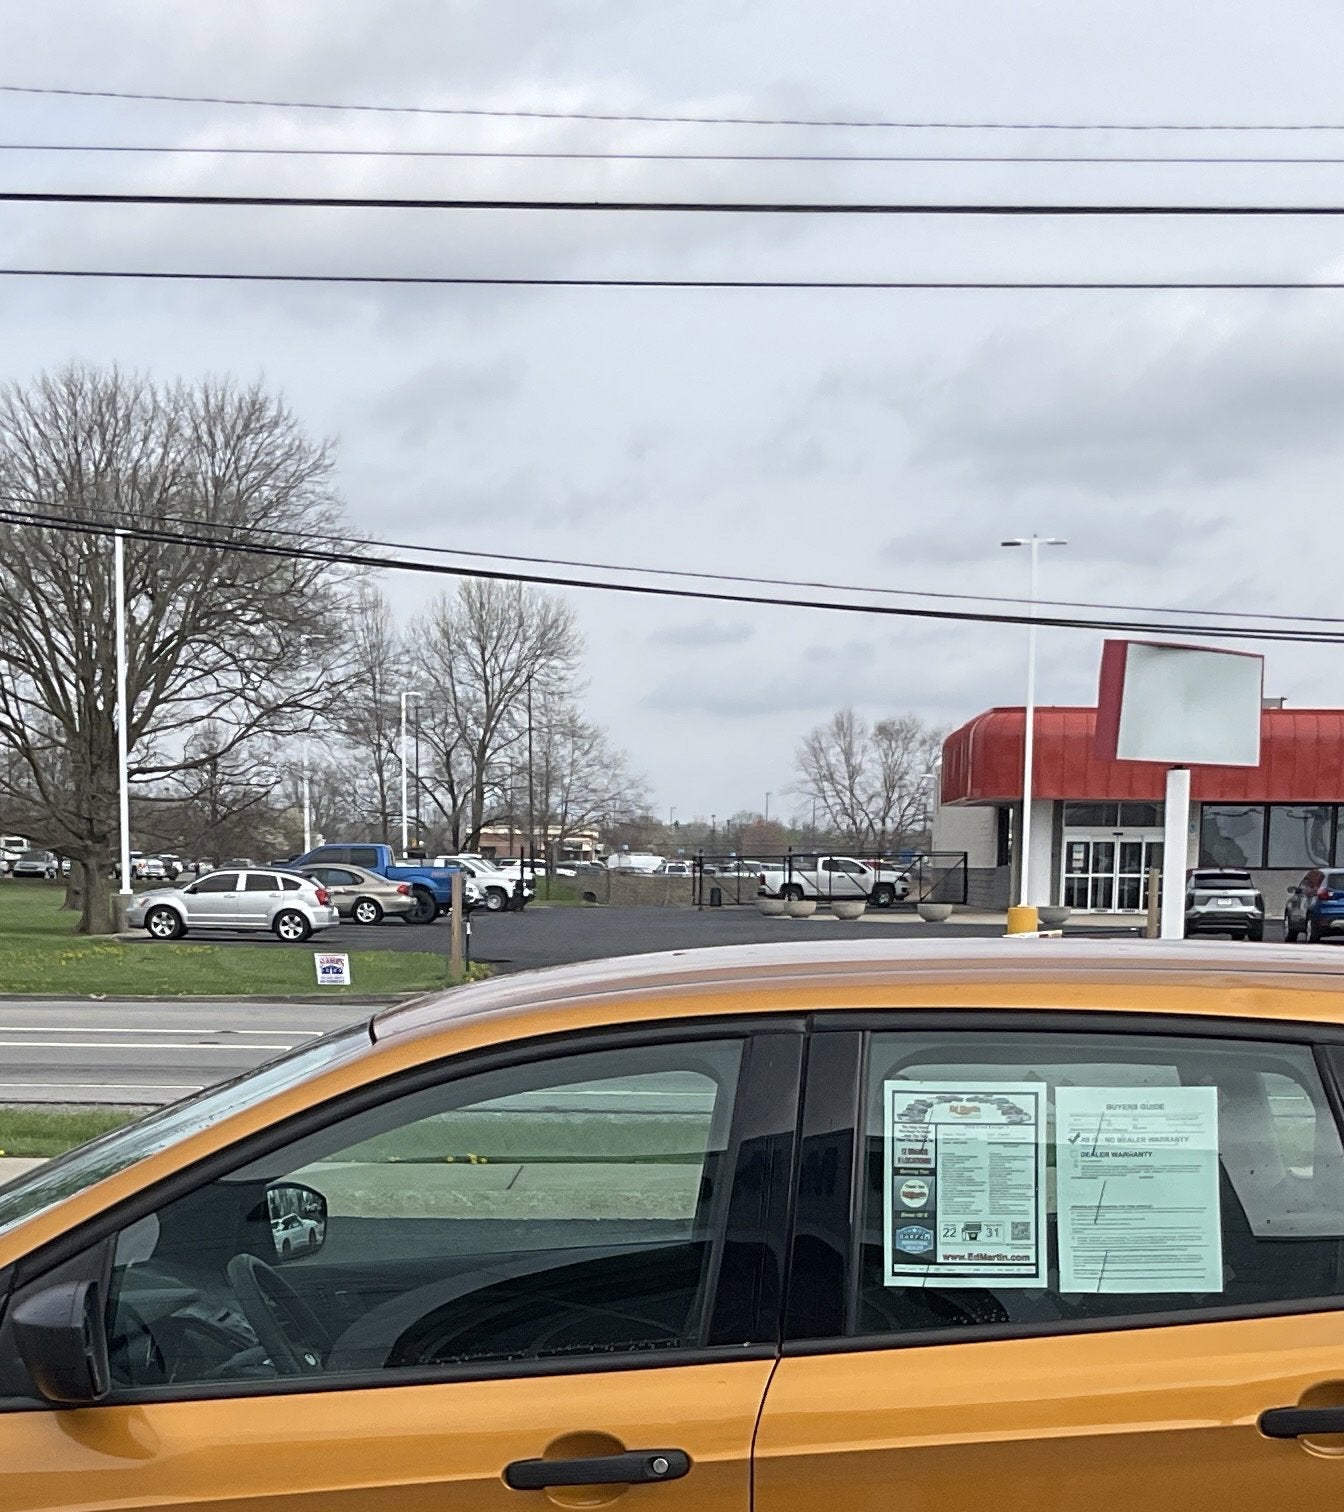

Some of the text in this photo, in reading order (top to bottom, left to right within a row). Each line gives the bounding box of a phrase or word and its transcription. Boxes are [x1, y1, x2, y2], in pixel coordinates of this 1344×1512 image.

[1140, 1103, 1165, 1111] GUIDE
[942, 1227, 999, 1238] 22 31
[942, 1252, 1031, 1262] www.EdMartin.com
